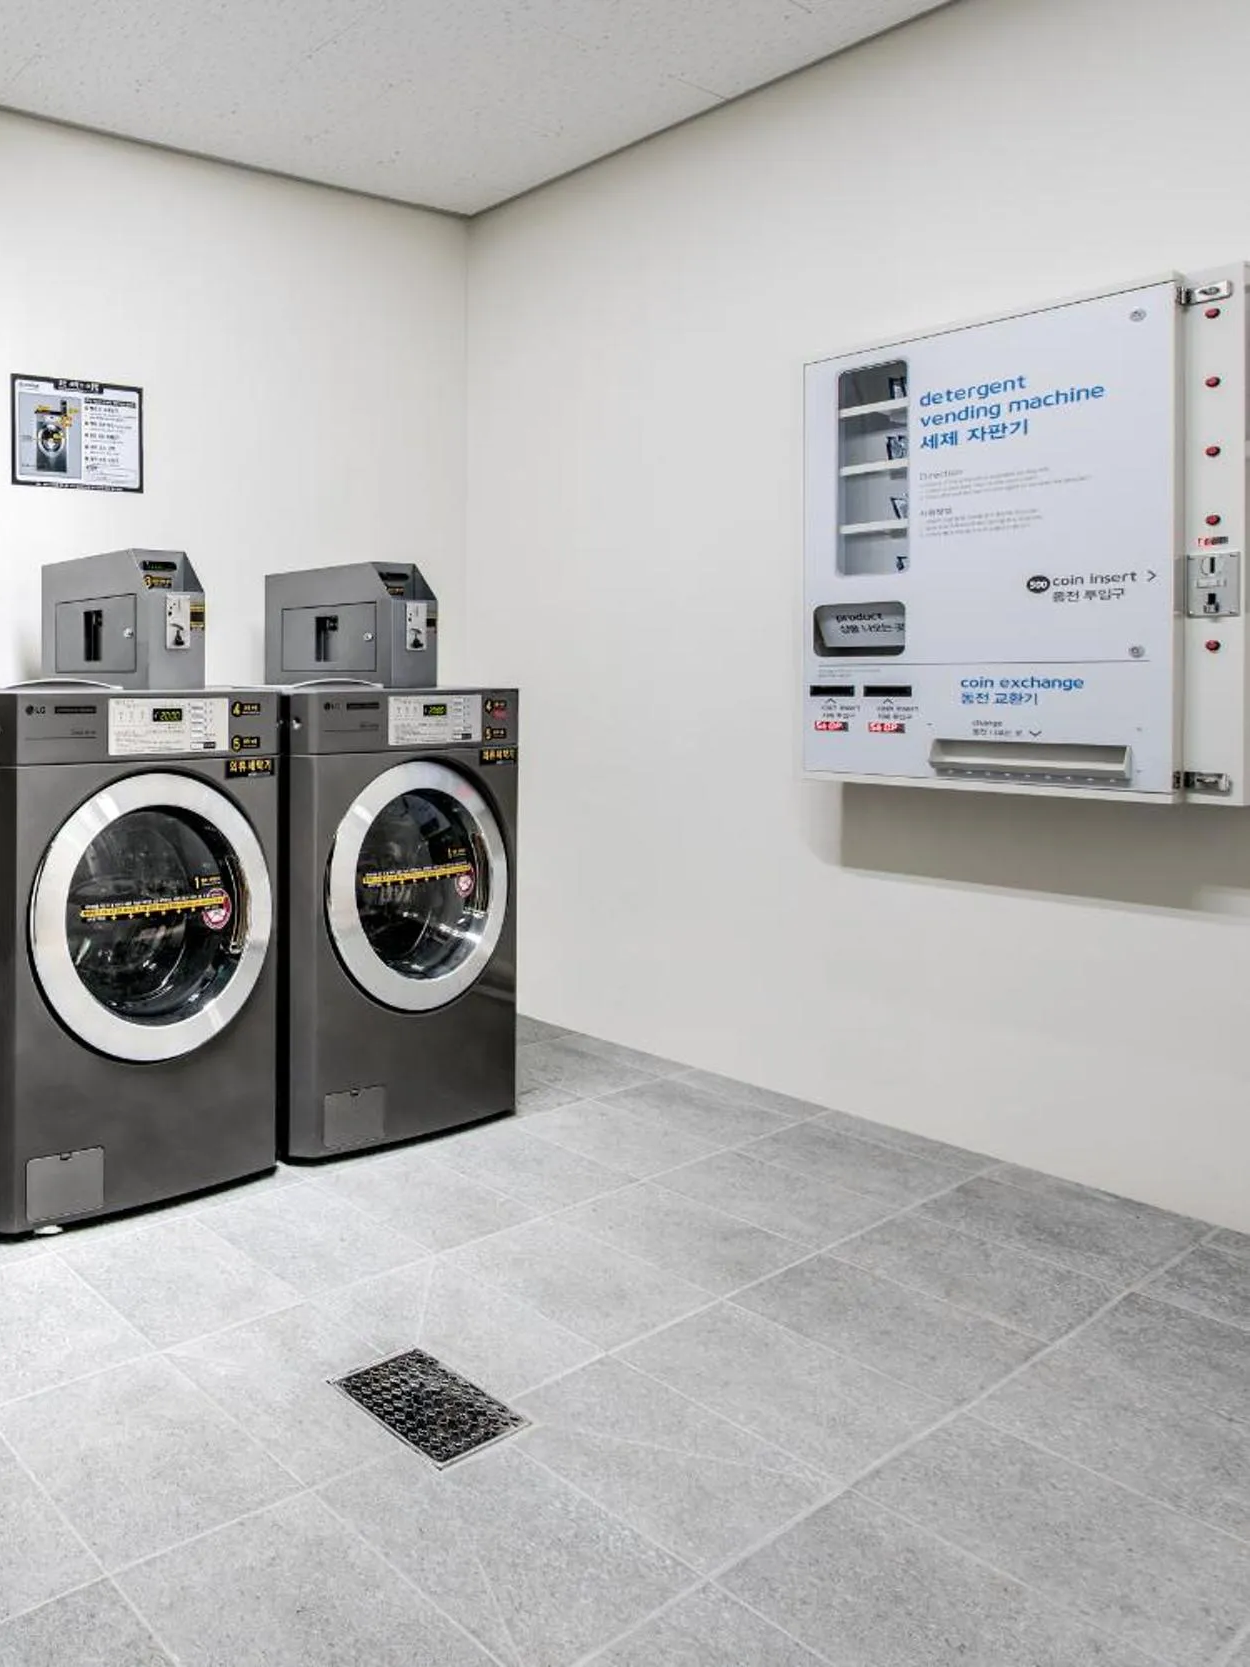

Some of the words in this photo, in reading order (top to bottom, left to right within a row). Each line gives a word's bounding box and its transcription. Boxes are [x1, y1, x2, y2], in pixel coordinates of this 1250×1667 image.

[919, 375, 1027, 407] detergent
[920, 403, 1001, 428] vending
[1009, 385, 1105, 413] machine
[920, 430, 959, 450] 세제
[967, 419, 1029, 442] 자판기
[1052, 575, 1084, 587] coin
[1089, 571, 1137, 585] insert
[1052, 590, 1080, 602] 동전
[1083, 587, 1125, 601] 투입구
[836, 612, 884, 623] product
[960, 676, 995, 689] coin
[999, 676, 1085, 691] exchange
[961, 693, 990, 705] 동전
[993, 692, 1039, 706] 교환기
[233, 703, 241, 715] 4
[971, 719, 1003, 727] change
[194, 876, 200, 889] 1
